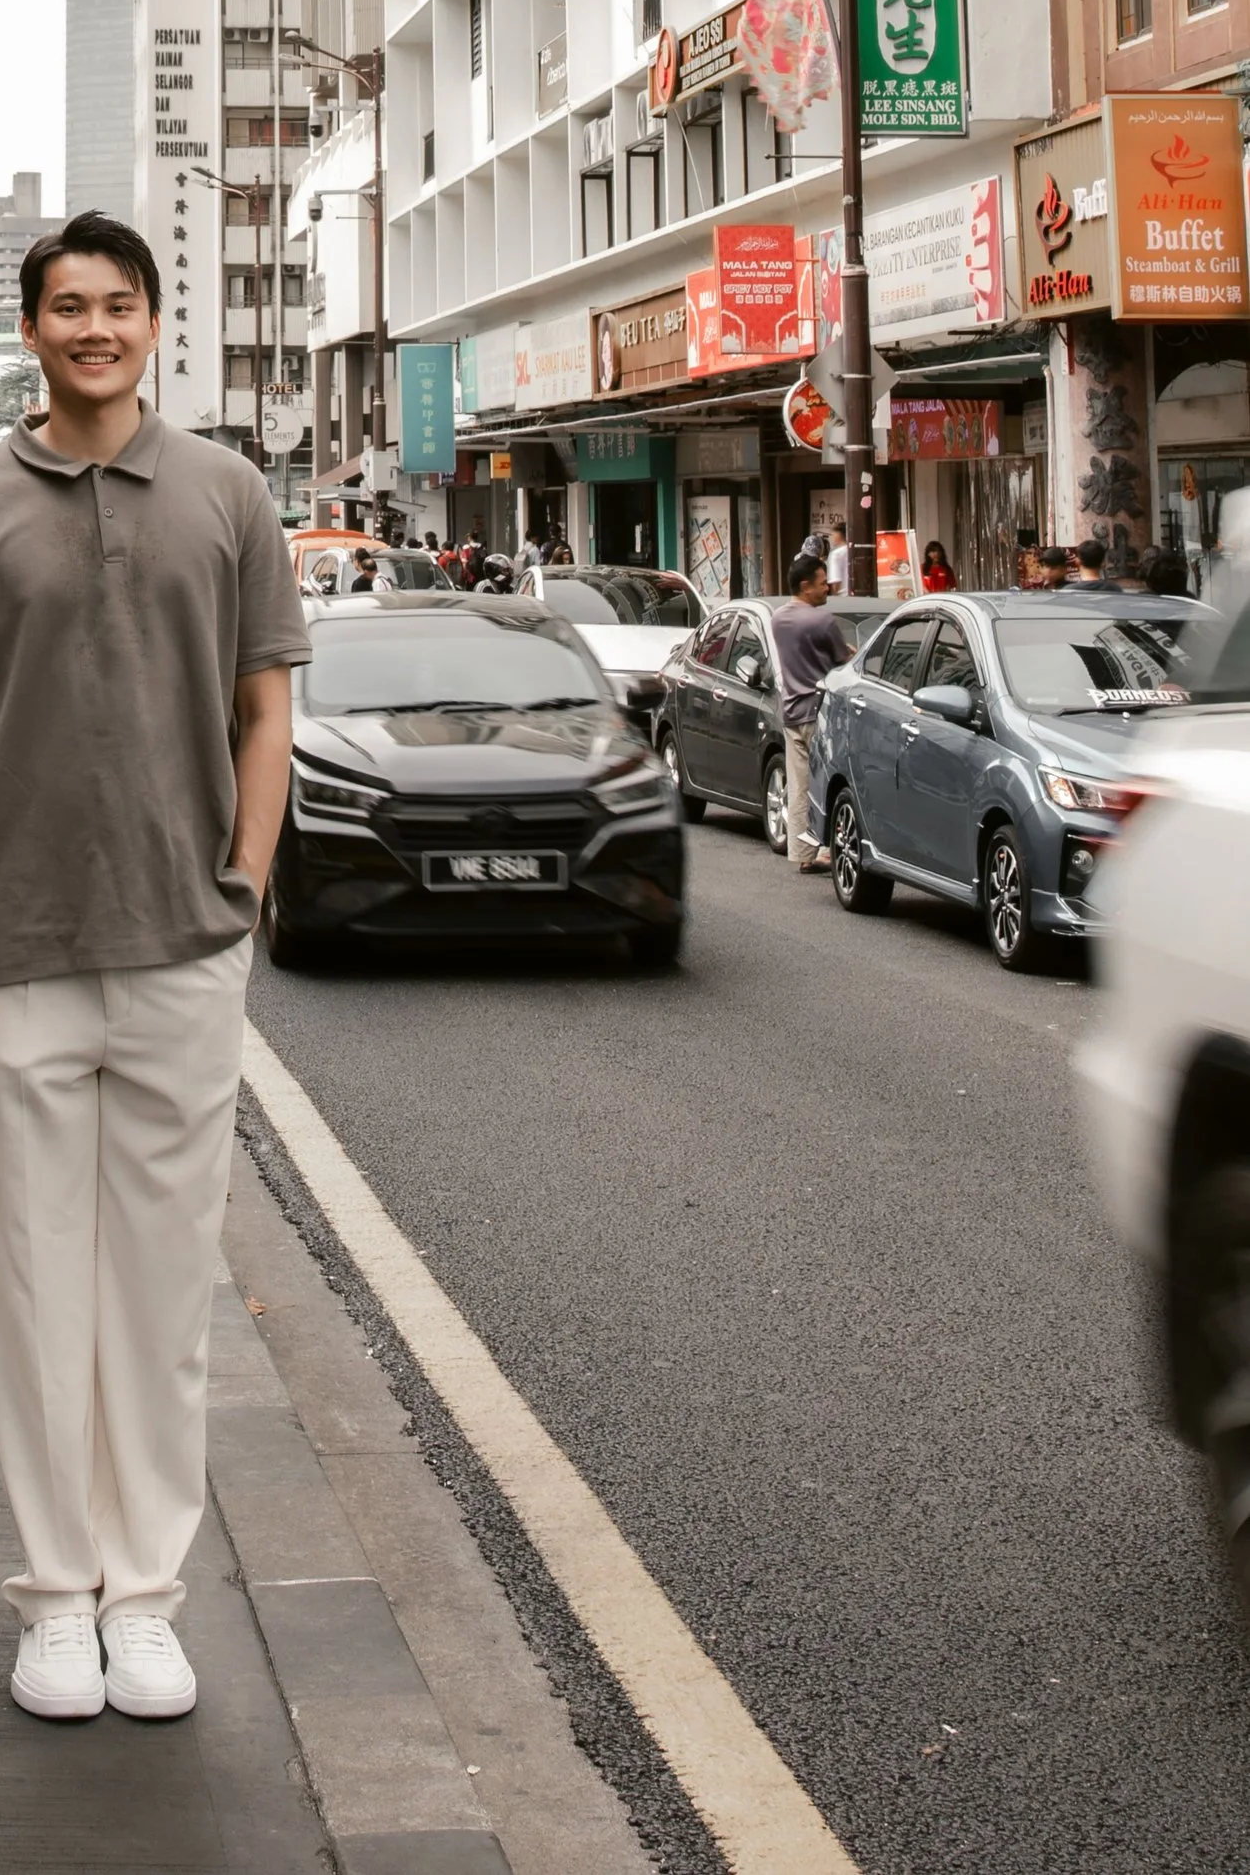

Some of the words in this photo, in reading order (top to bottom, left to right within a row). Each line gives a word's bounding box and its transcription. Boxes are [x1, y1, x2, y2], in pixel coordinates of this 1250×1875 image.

[155, 29, 201, 45] PERSATUAN
[155, 52, 183, 67] HAINAN
[155, 74, 194, 90] SELANGOR
[155, 97, 170, 112] DAN
[864, 99, 893, 113] LEE
[895, 98, 956, 113] SINSANG
[155, 119, 187, 135] WILAYAH
[862, 113, 898, 126] MOLE
[901, 113, 928, 126] SDN.
[930, 113, 960, 126] BHD.
[156, 141, 208, 157] PERSEKUTUAN
[870, 227, 904, 250] BARANGAN
[904, 214, 945, 242] KECANTIKAN
[946, 206, 965, 227] KUKU
[1145, 219, 1225, 251] Buffet
[906, 235, 962, 269] ENTERPRISE
[722, 261, 758, 270] MALA
[760, 261, 793, 270] TANG
[1125, 256, 1191, 273] Steamboat
[1194, 258, 1206, 273] &
[1209, 256, 1241, 273] Grill
[752, 283, 772, 294] HOT
[774, 283, 794, 294] POT
[1129, 284, 1243, 305] 穆斯林自助火锅
